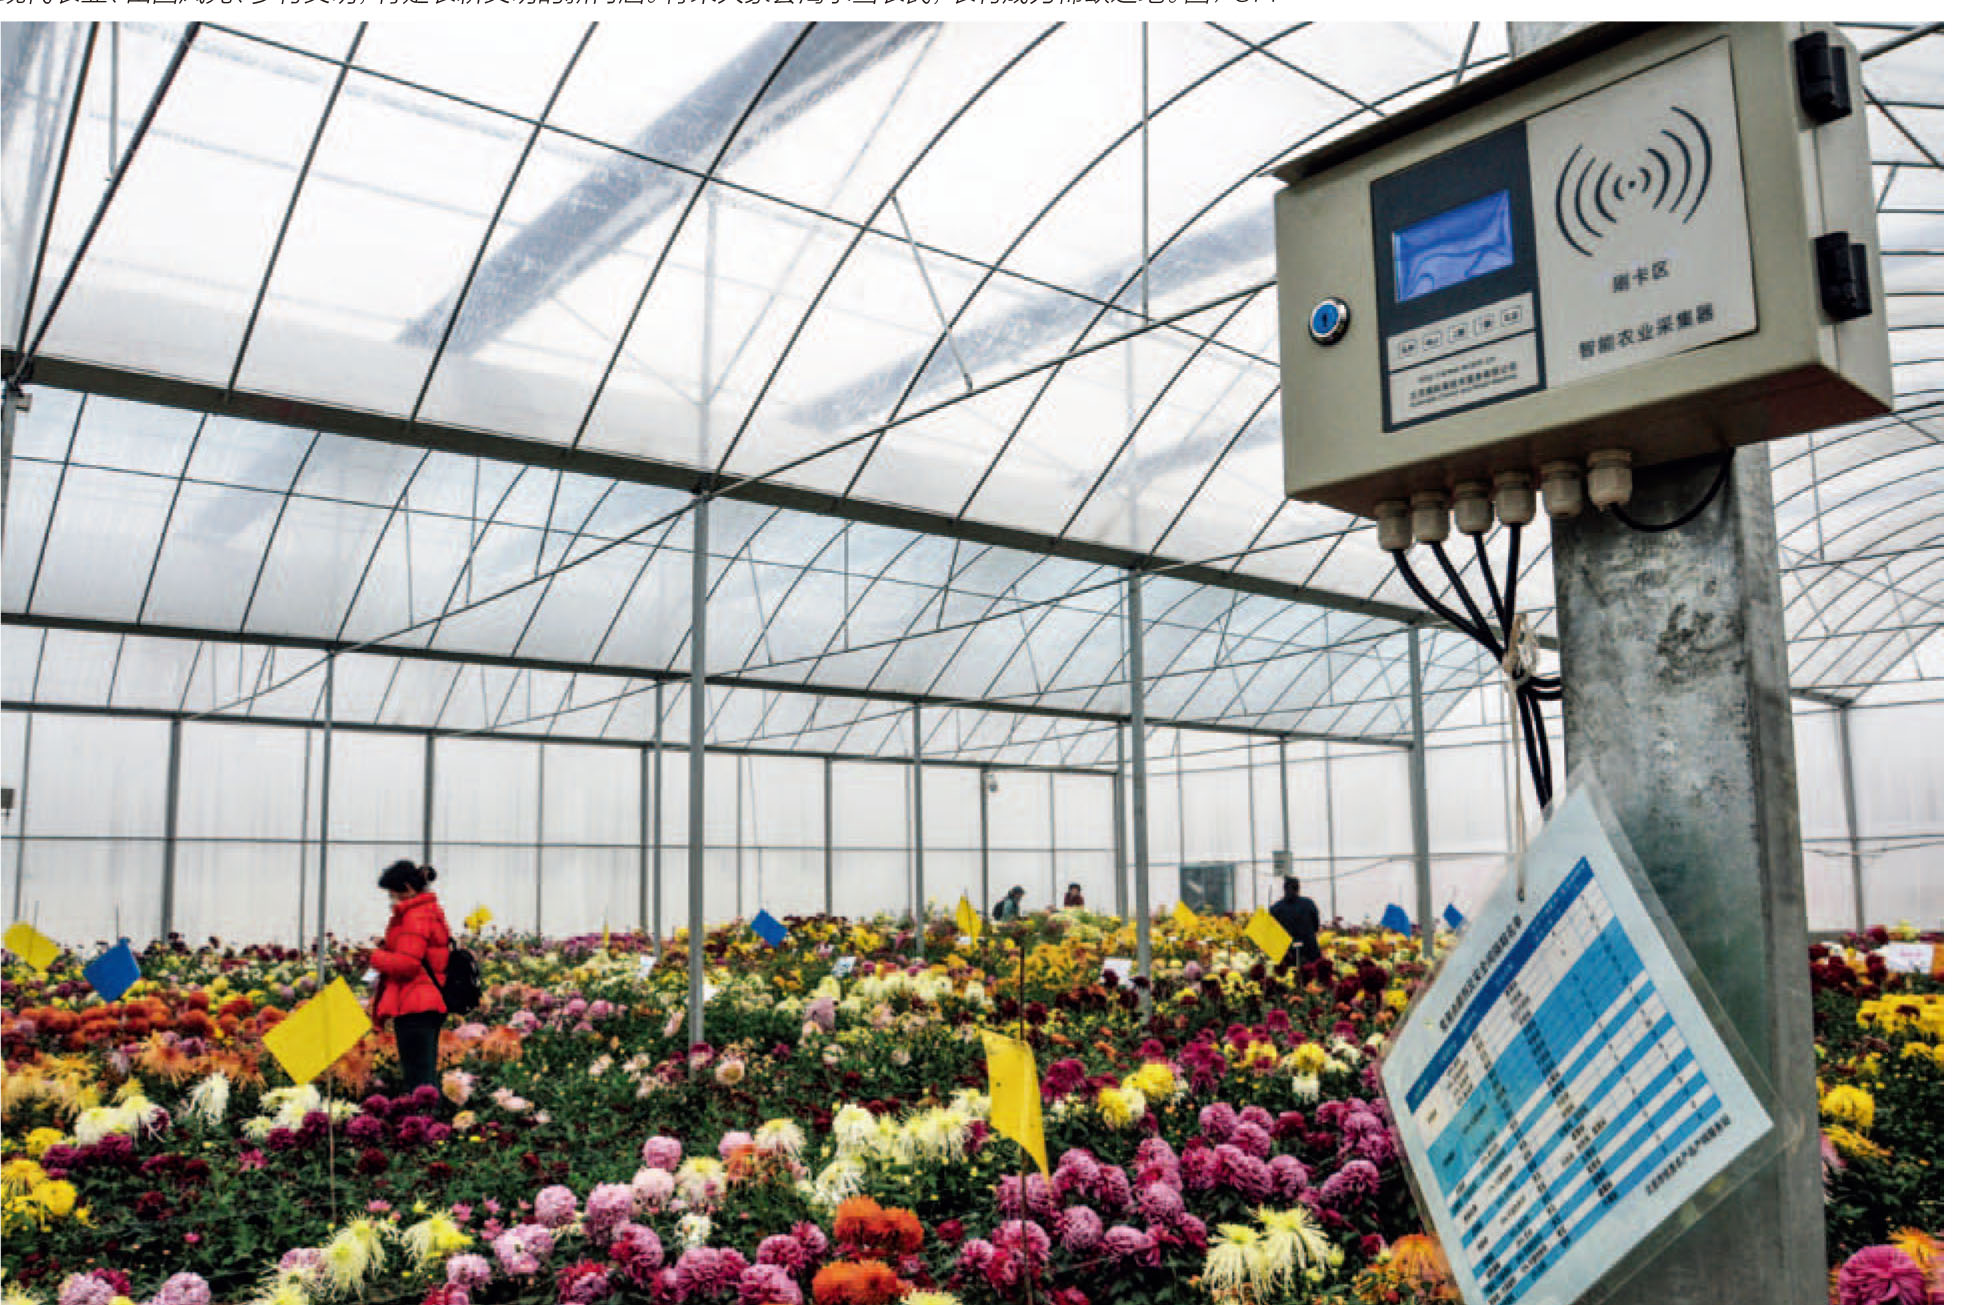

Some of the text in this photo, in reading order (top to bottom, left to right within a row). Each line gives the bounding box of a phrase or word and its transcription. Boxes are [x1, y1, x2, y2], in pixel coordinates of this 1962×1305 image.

[1612, 260, 1669, 293] 刷卡区
[1579, 303, 1713, 359] 智能农业采集器
